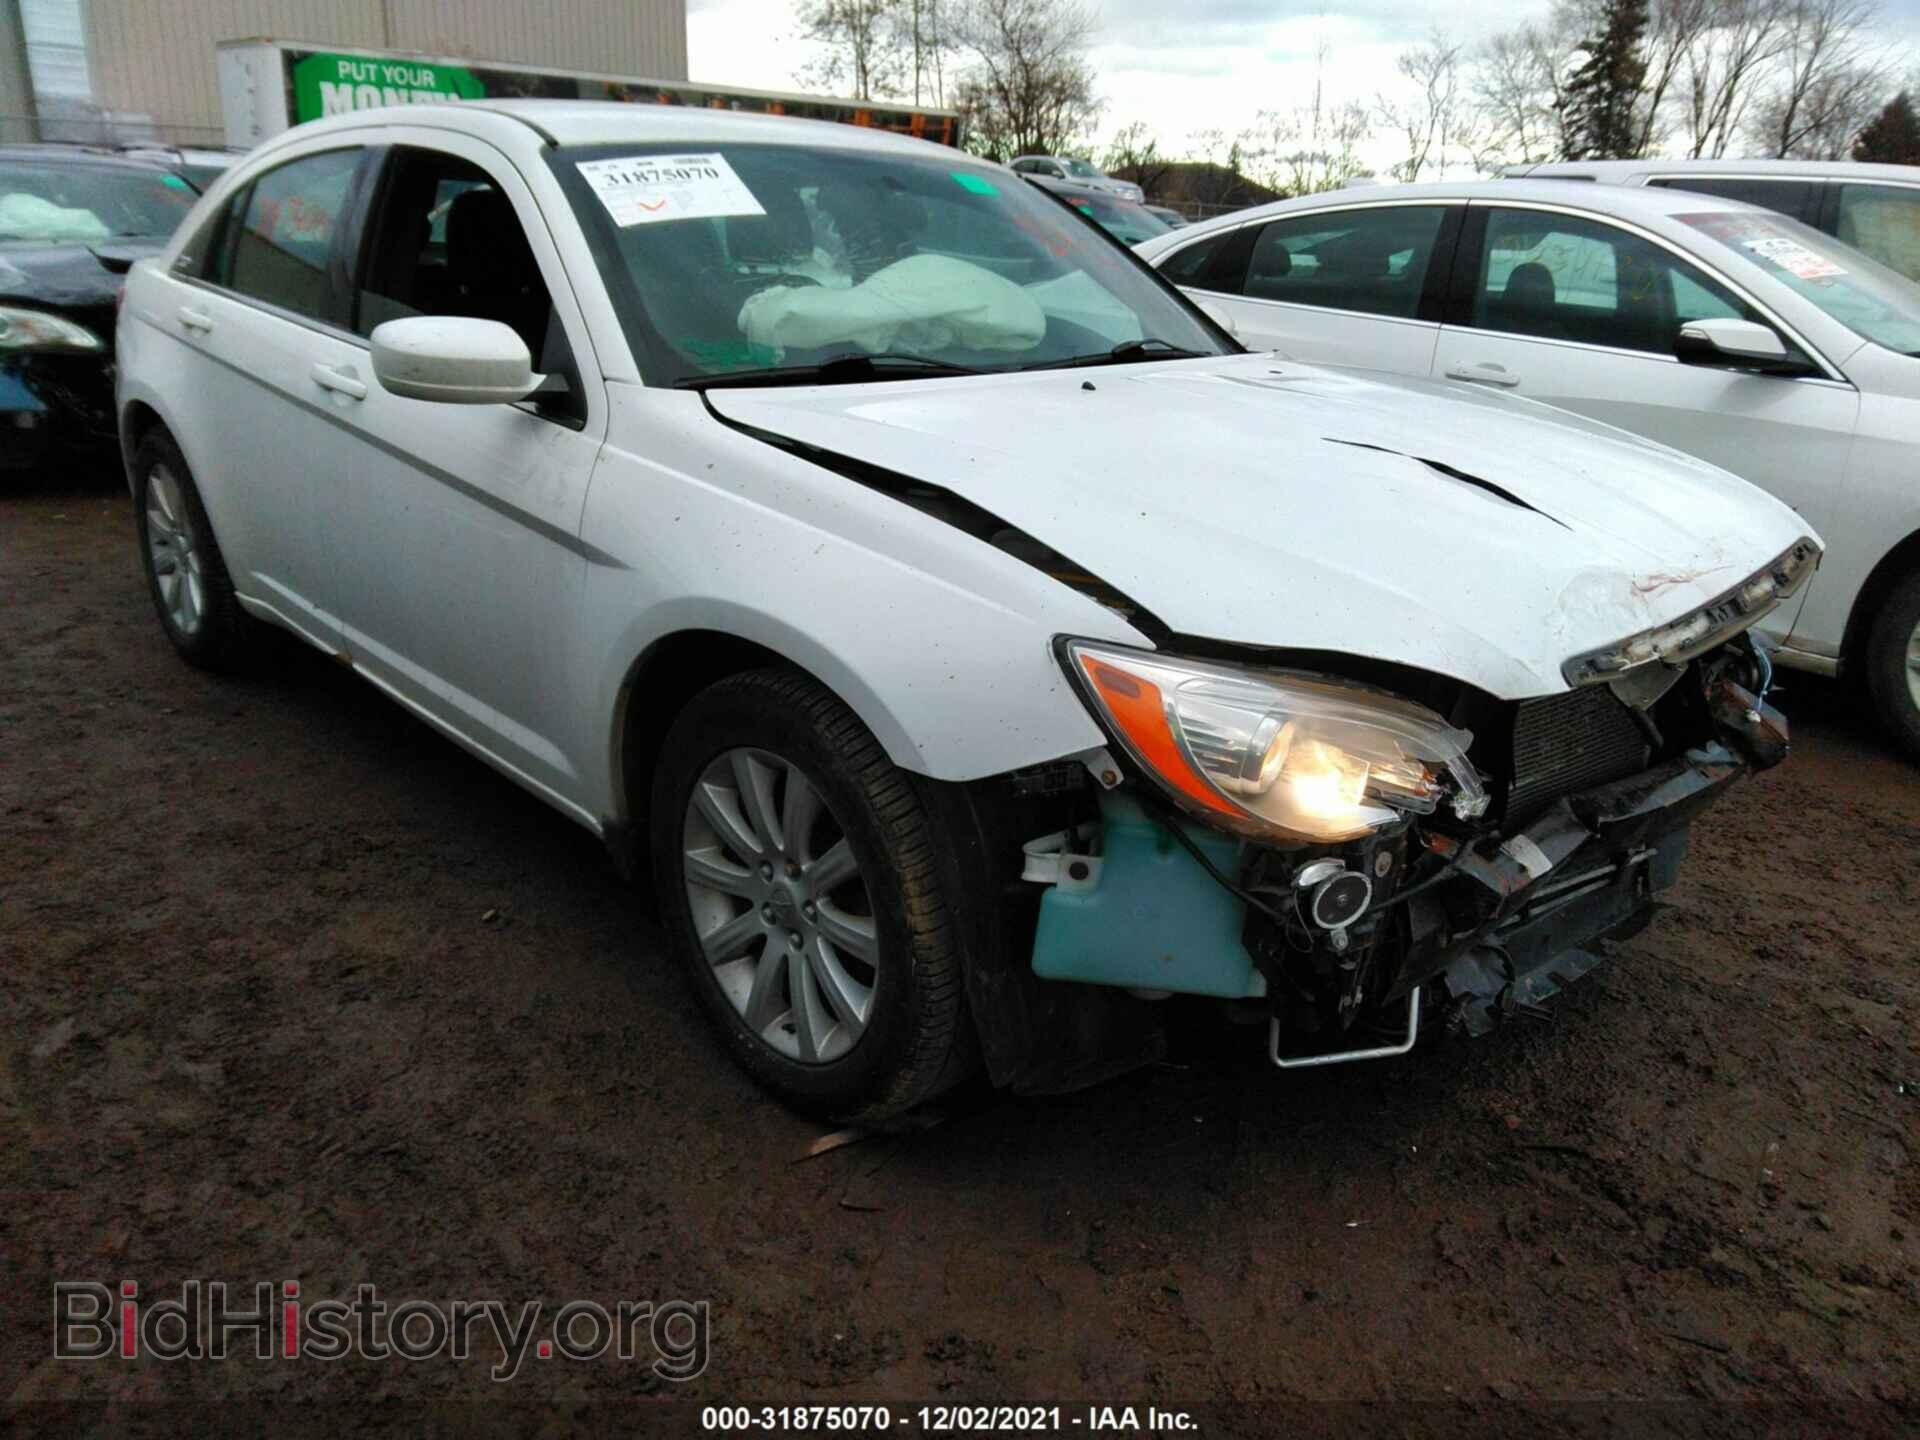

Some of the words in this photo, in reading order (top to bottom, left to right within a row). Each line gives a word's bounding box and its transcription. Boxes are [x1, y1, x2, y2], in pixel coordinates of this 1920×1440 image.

[337, 60, 377, 81] PUT
[381, 65, 435, 88] YOUR
[603, 167, 719, 187] 31875070
